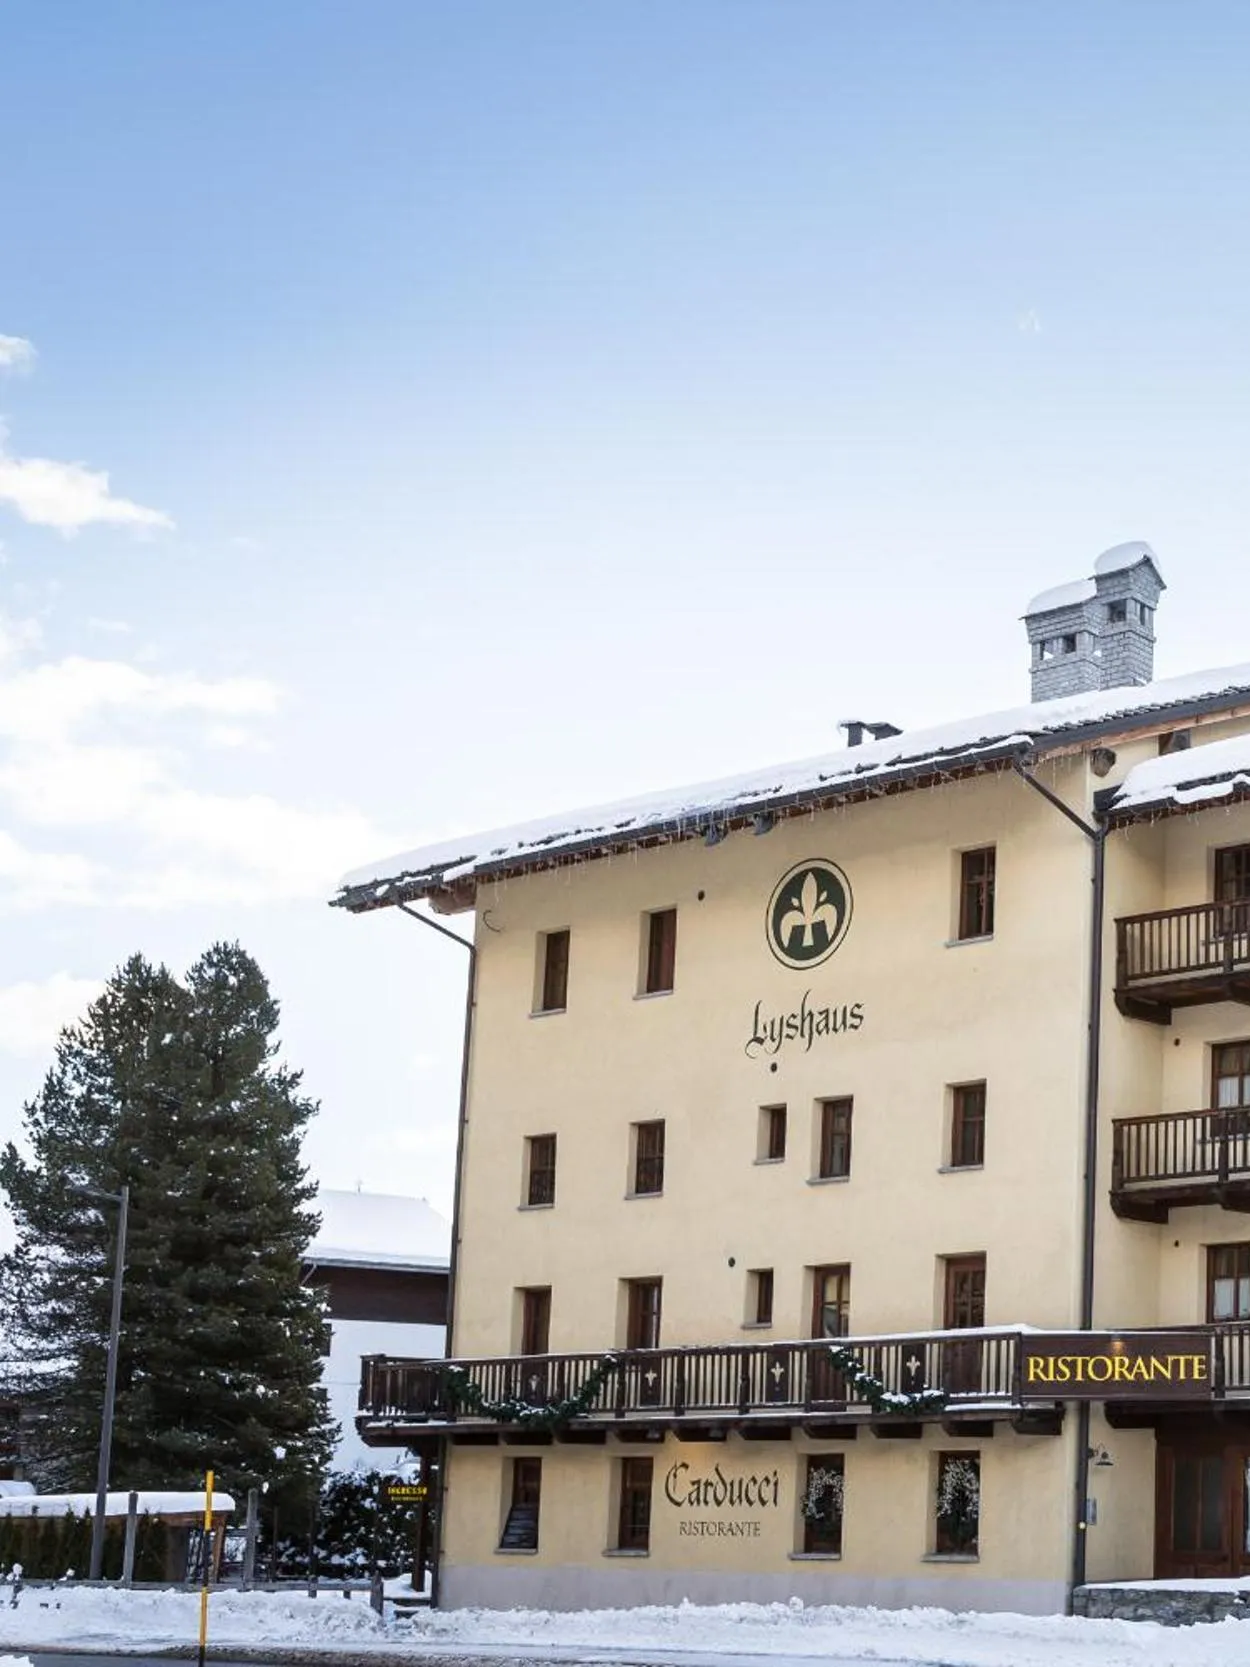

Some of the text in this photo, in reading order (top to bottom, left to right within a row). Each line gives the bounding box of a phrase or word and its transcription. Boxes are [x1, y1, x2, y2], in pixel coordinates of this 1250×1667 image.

[744, 988, 864, 1059] Lyshaus
[1027, 1355, 1208, 1381] RISTORANTE
[665, 1459, 778, 1507] Carducci
[679, 1520, 761, 1537] RISTORANTE
